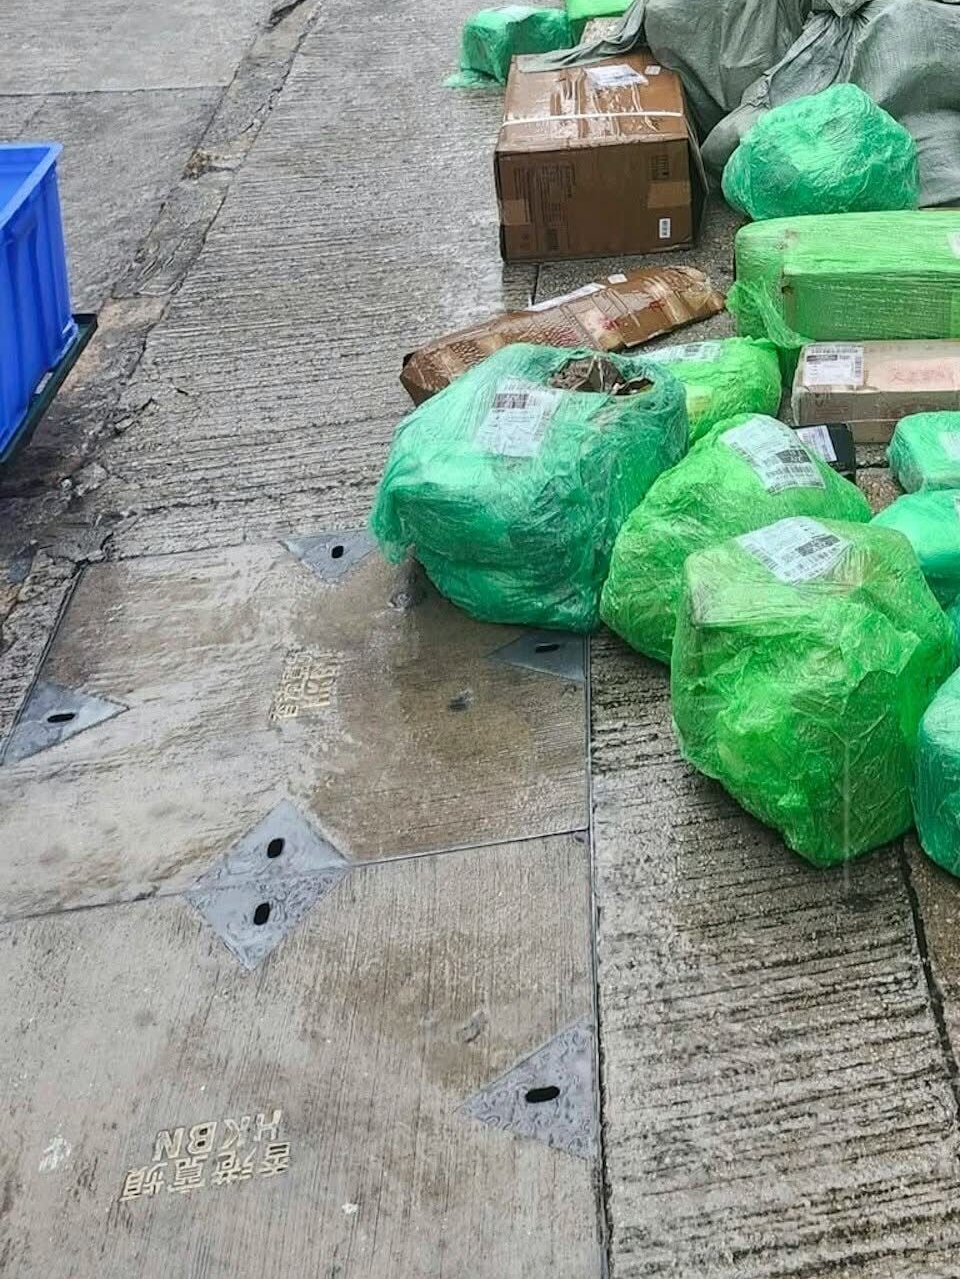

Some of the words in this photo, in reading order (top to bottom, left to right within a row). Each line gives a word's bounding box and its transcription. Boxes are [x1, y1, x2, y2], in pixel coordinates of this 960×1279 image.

[152, 1109, 282, 1161] HKBN
[119, 1141, 290, 1201] 香港寬頻
